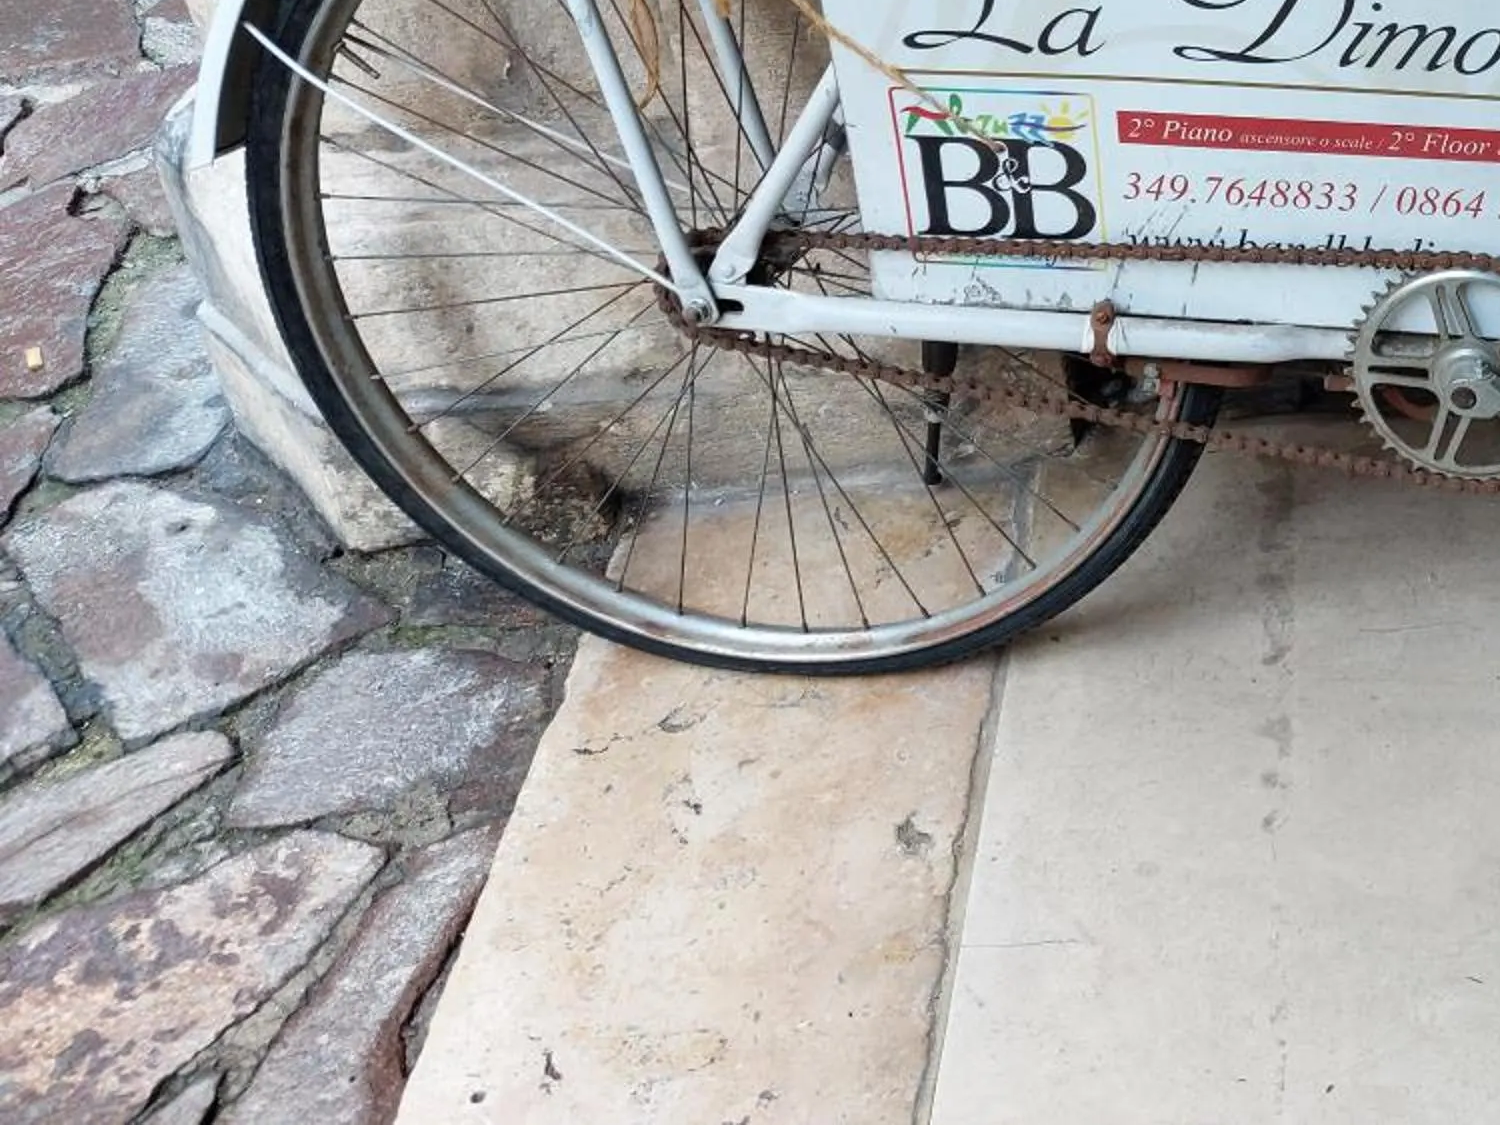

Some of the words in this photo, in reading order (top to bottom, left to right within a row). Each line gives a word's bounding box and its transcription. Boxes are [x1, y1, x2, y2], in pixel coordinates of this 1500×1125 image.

[1162, 119, 1233, 143] Piano
[1239, 133, 1316, 148] ascensore
[1332, 135, 1373, 151] scale
[1420, 133, 1492, 156] Floor
[904, 134, 1097, 241] B&B
[1123, 171, 1359, 212] 349.7648833
[1396, 186, 1486, 219] 0864
